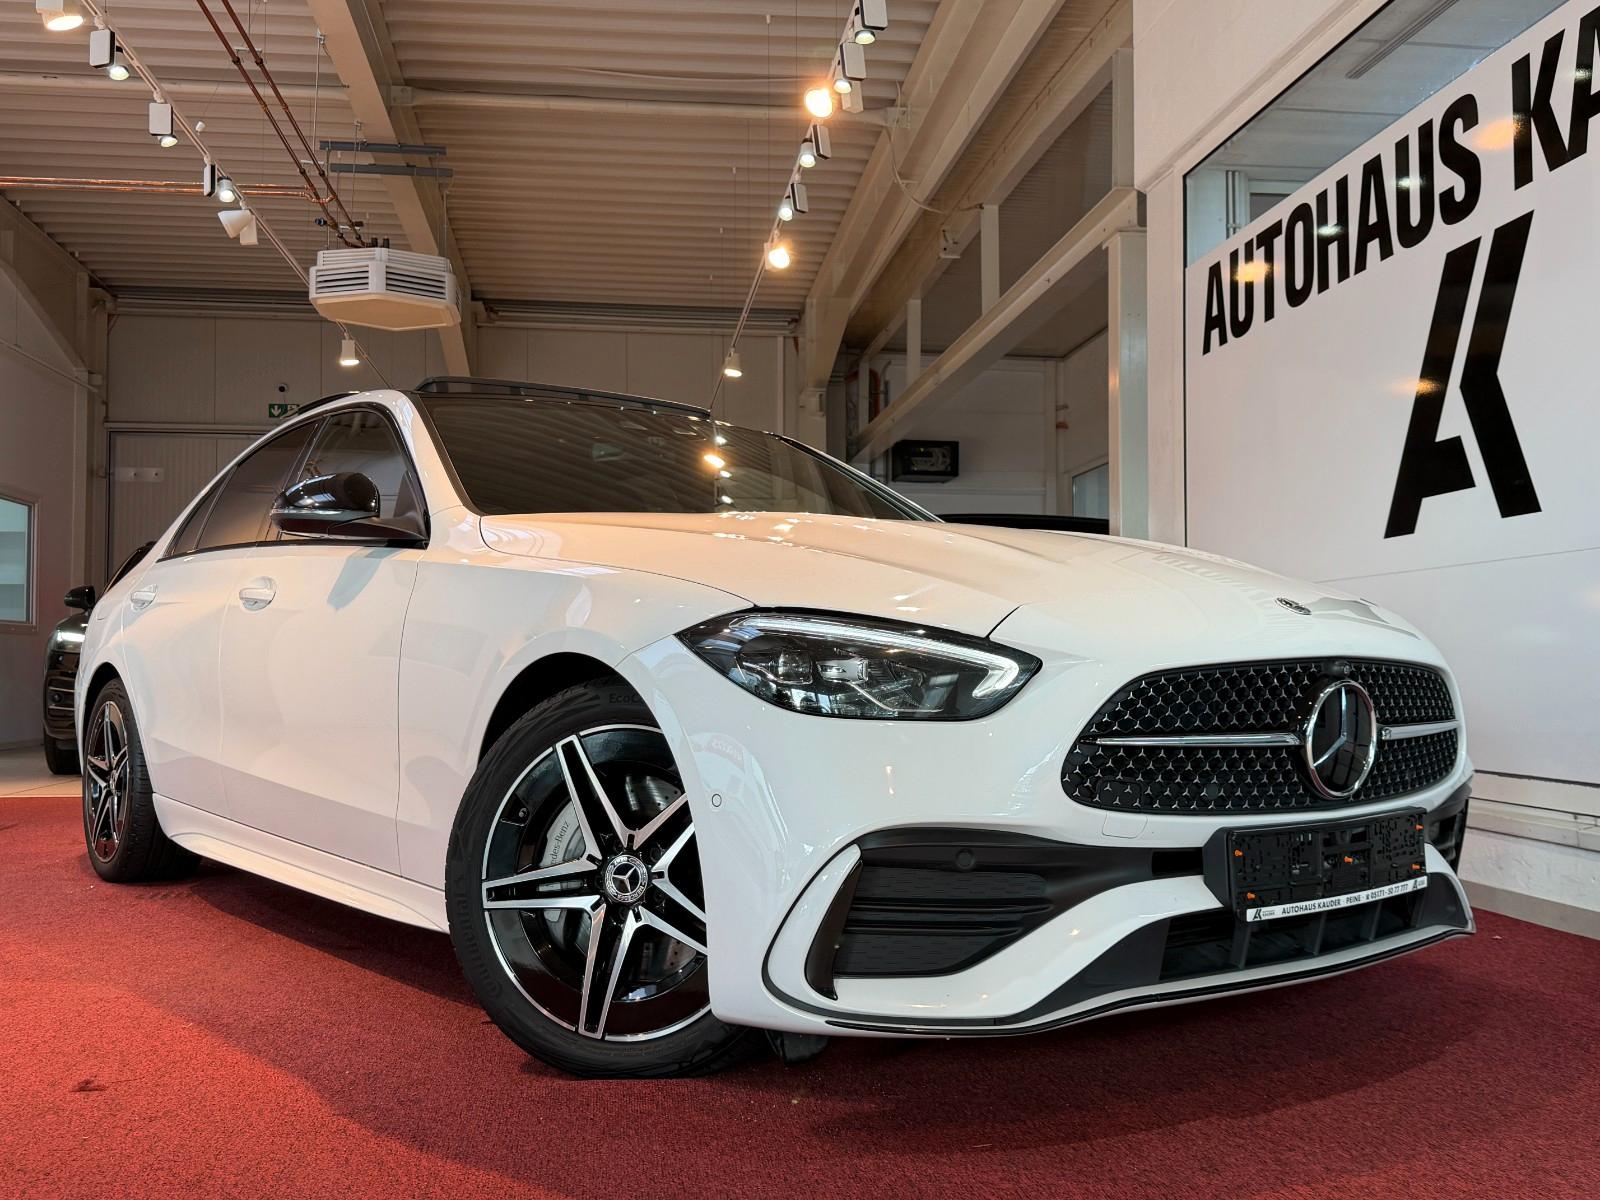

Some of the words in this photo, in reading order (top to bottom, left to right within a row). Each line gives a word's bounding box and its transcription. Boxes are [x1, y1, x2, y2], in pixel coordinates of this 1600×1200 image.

[1202, 93, 1482, 356] AUTOHAUS
[1281, 902, 1317, 915] AUTOHAUS
[1317, 899, 1341, 909] KAUDER
[1346, 895, 1361, 904] PEINE
